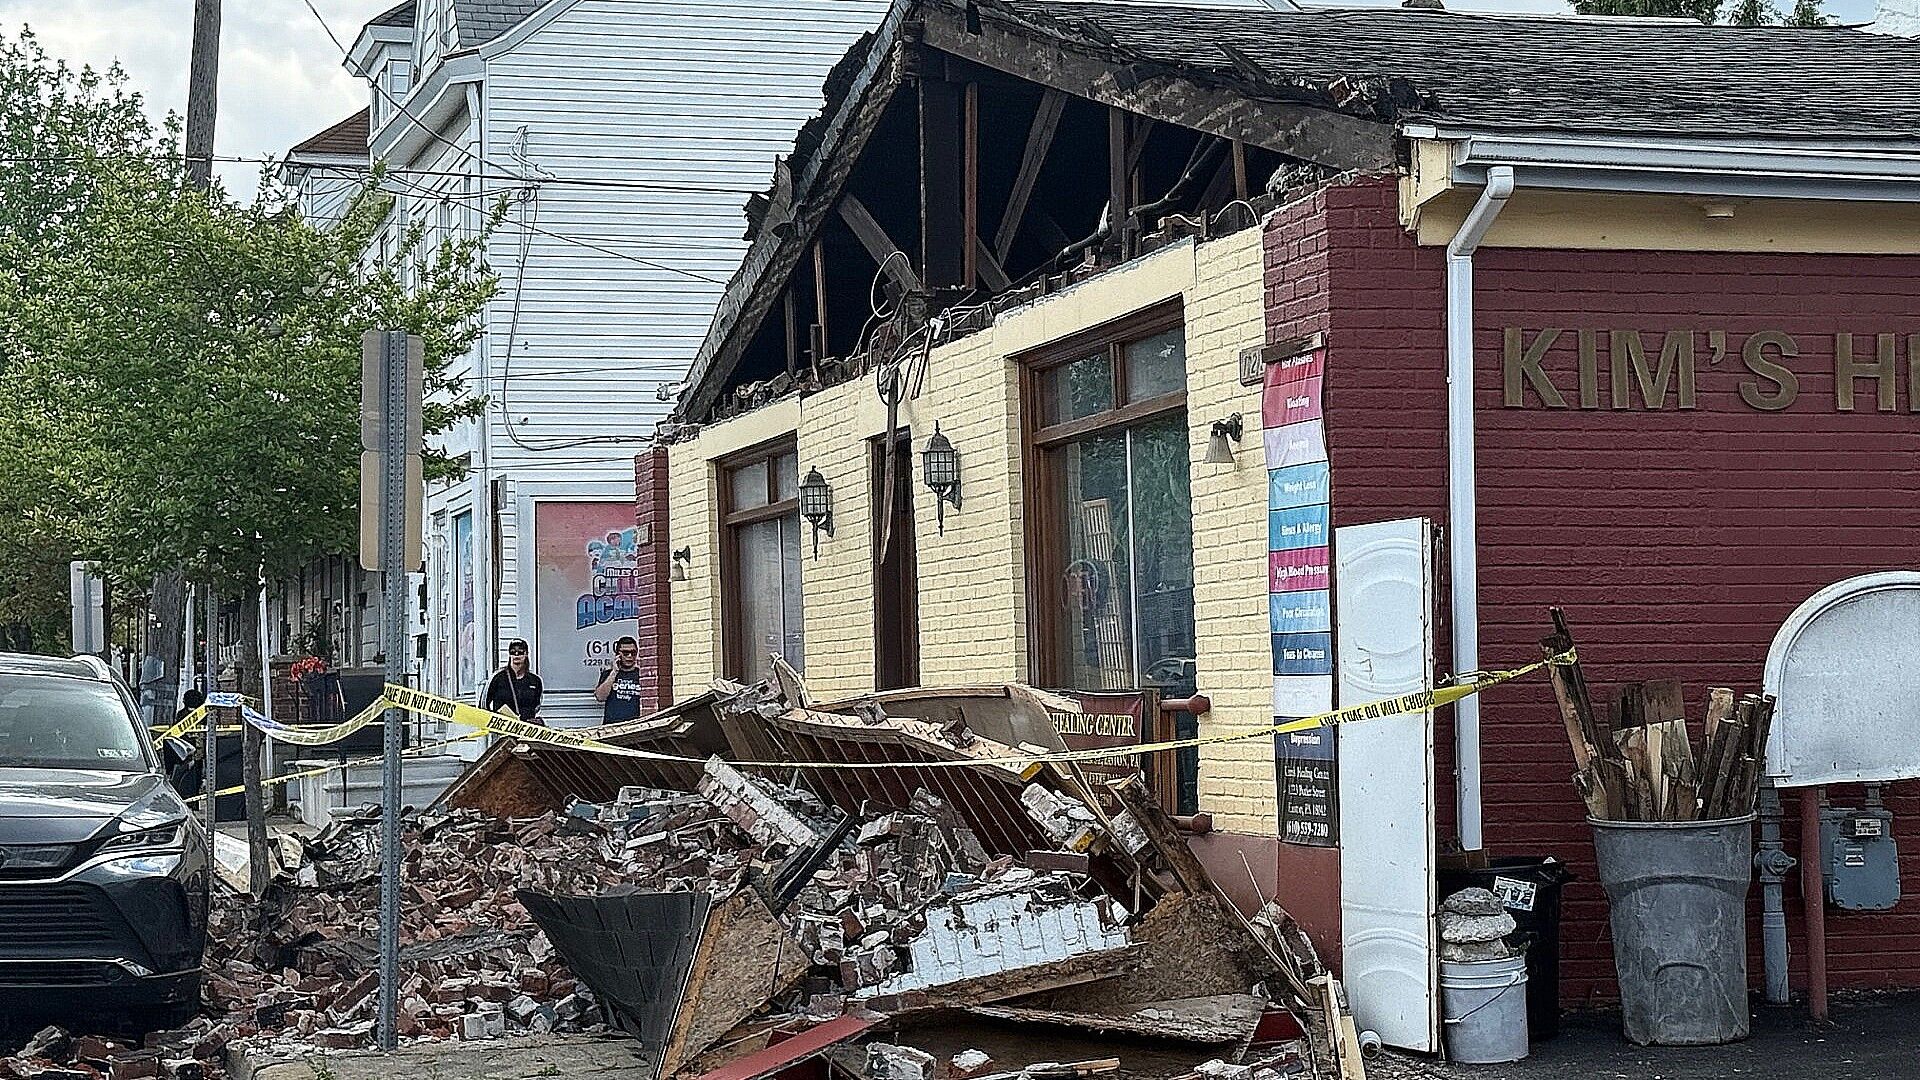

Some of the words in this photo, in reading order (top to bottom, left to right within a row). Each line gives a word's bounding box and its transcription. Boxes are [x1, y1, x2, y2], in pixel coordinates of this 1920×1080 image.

[1503, 328, 1800, 411] KIM'S
[1835, 332, 1920, 411] H
[399, 690, 411, 706] DO
[411, 694, 429, 711] NOT
[429, 699, 456, 718] CROSS
[487, 715, 508, 732] FIRE
[505, 720, 525, 736] LINE
[524, 726, 539, 740] DO
[535, 729, 558, 742] NOT
[1052, 712, 1095, 736] HEALING
[1095, 713, 1136, 737] CENTER
